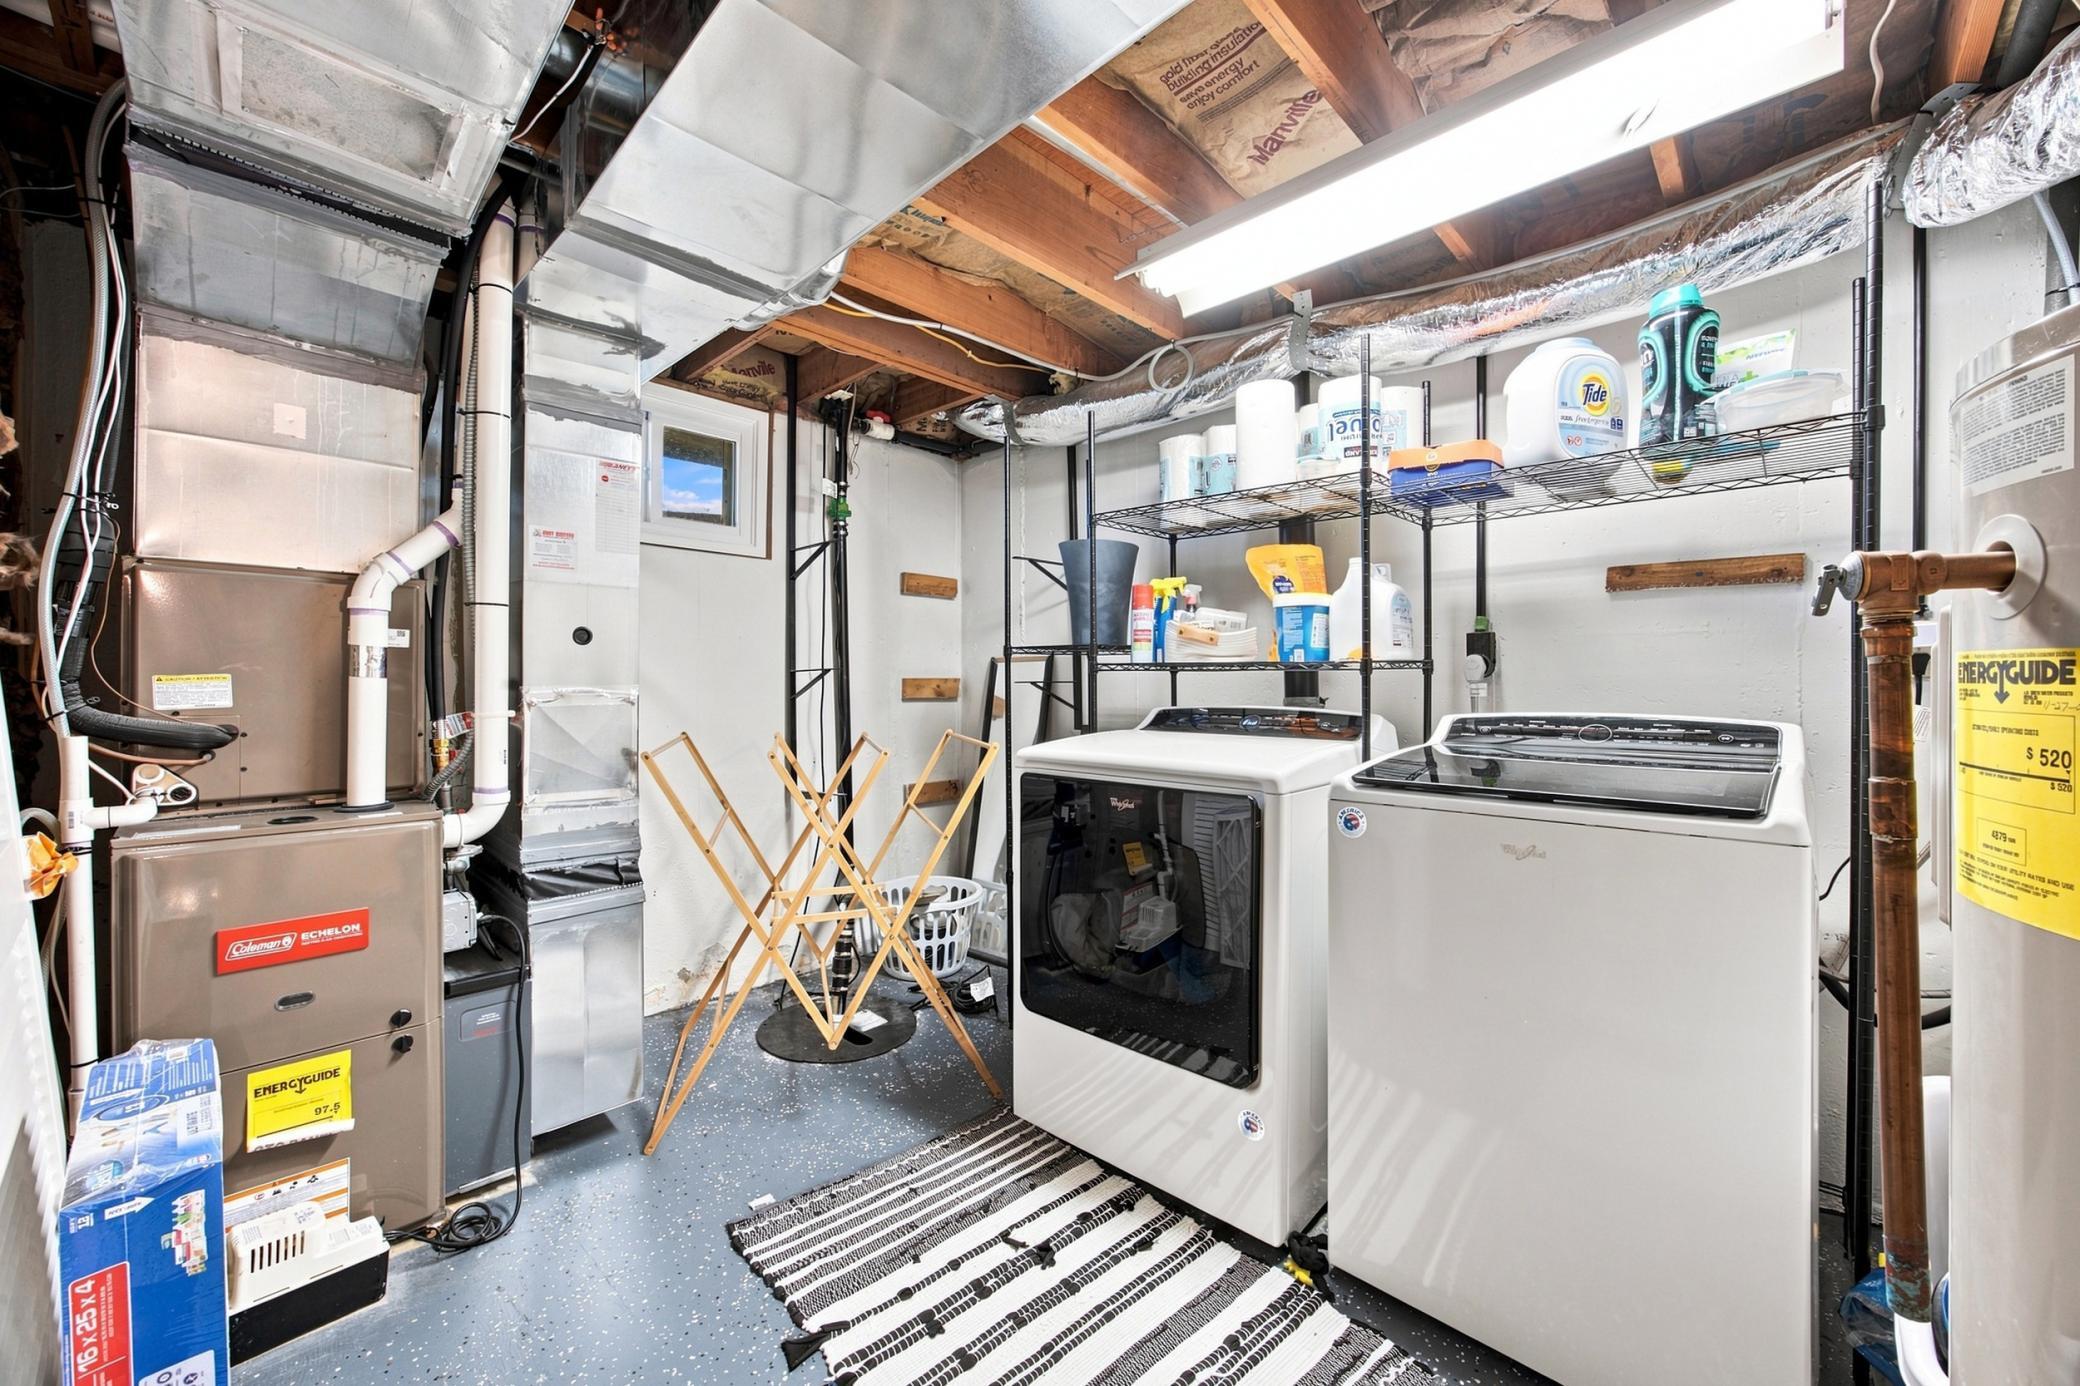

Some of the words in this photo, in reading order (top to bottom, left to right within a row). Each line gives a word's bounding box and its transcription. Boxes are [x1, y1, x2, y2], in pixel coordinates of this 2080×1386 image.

[1167, 58, 1213, 92] building
[1209, 21, 1262, 64] insulatio
[1160, 61, 1184, 83] gold
[1186, 91, 1216, 110] enjoy
[1216, 59, 1260, 95] comfort
[1205, 57, 1244, 88] energy
[1248, 89, 1321, 165] Manville
[1582, 383, 1608, 406] Tide
[1958, 659, 2077, 686] ENERGYGUIDE
[2026, 747, 2034, 760] $
[2039, 748, 2072, 769] 520
[2057, 782, 2073, 793] 520
[231, 940, 282, 955] Coleman
[301, 923, 361, 940] ECHELON
[253, 1067, 341, 1099] ENERGYGUIDE
[314, 1102, 341, 1116] 97.5
[74, 1279, 96, 1294] 4
[75, 1308, 98, 1335] 25
[76, 1350, 99, 1373] 16
